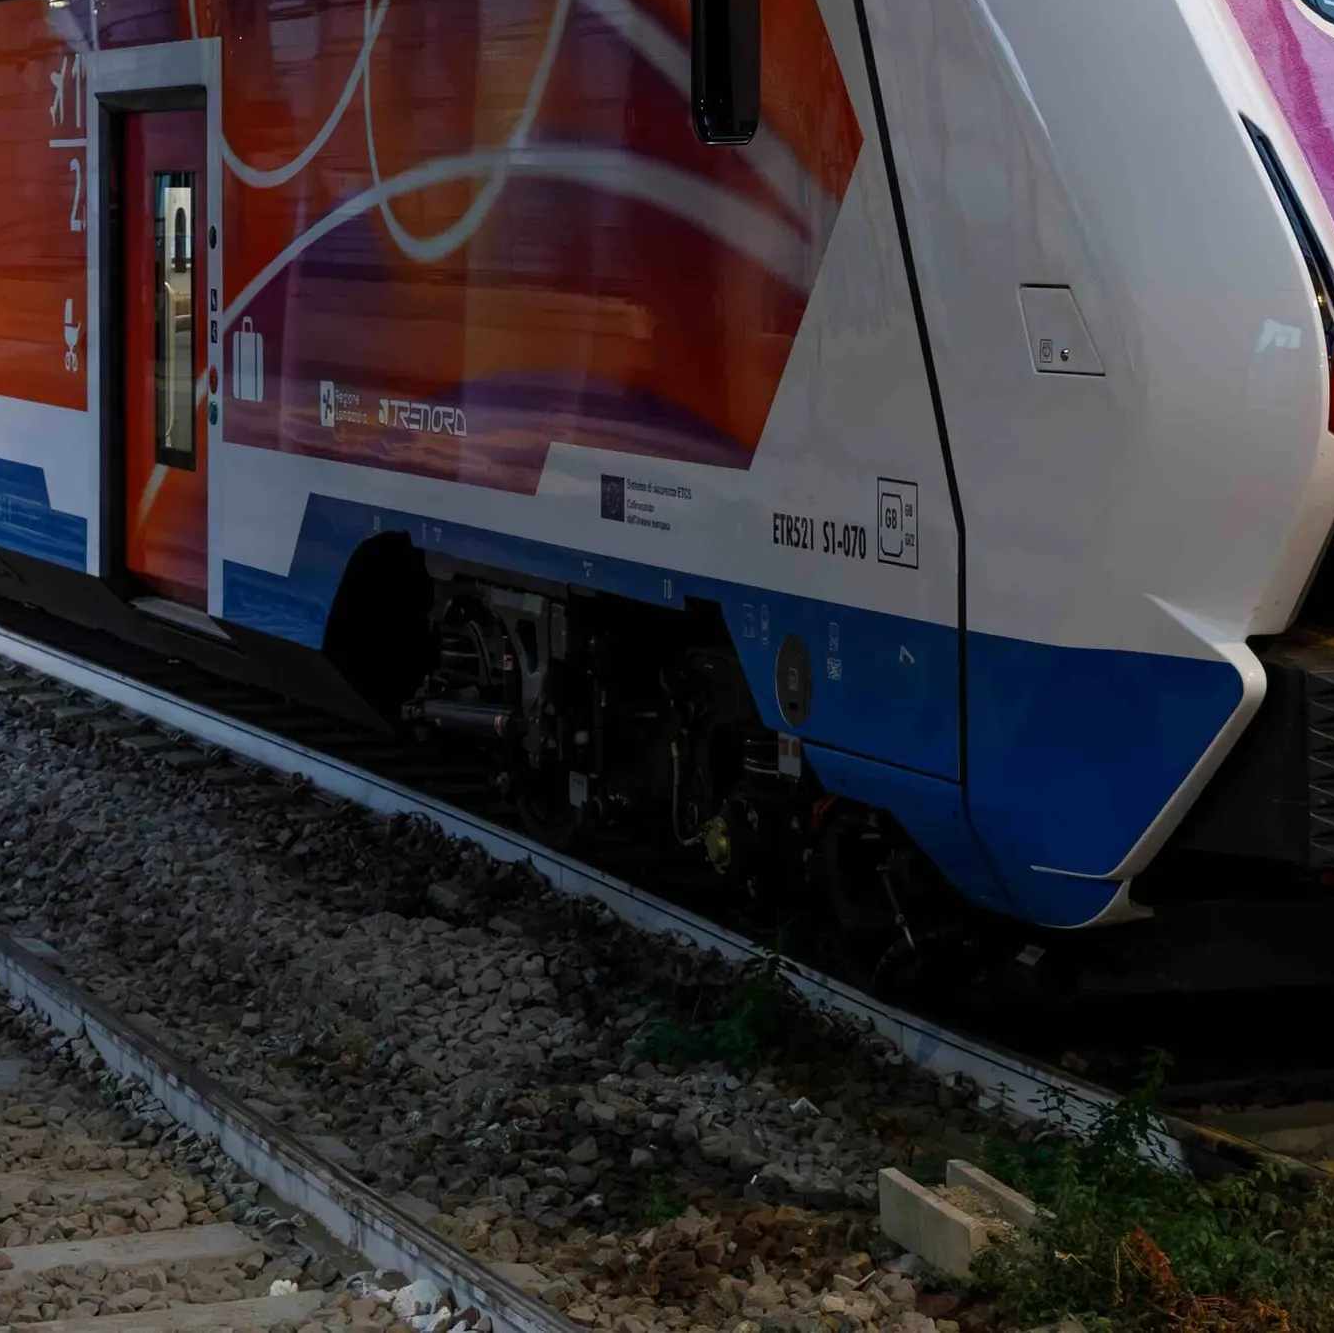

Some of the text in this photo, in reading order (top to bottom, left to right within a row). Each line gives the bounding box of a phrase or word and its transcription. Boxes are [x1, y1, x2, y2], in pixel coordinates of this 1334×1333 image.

[69, 158, 82, 231] 2
[389, 400, 467, 437] TRENORD
[677, 487, 692, 500] ETCS
[773, 512, 867, 560] ETR521 S1-070
[885, 508, 898, 529] GB
